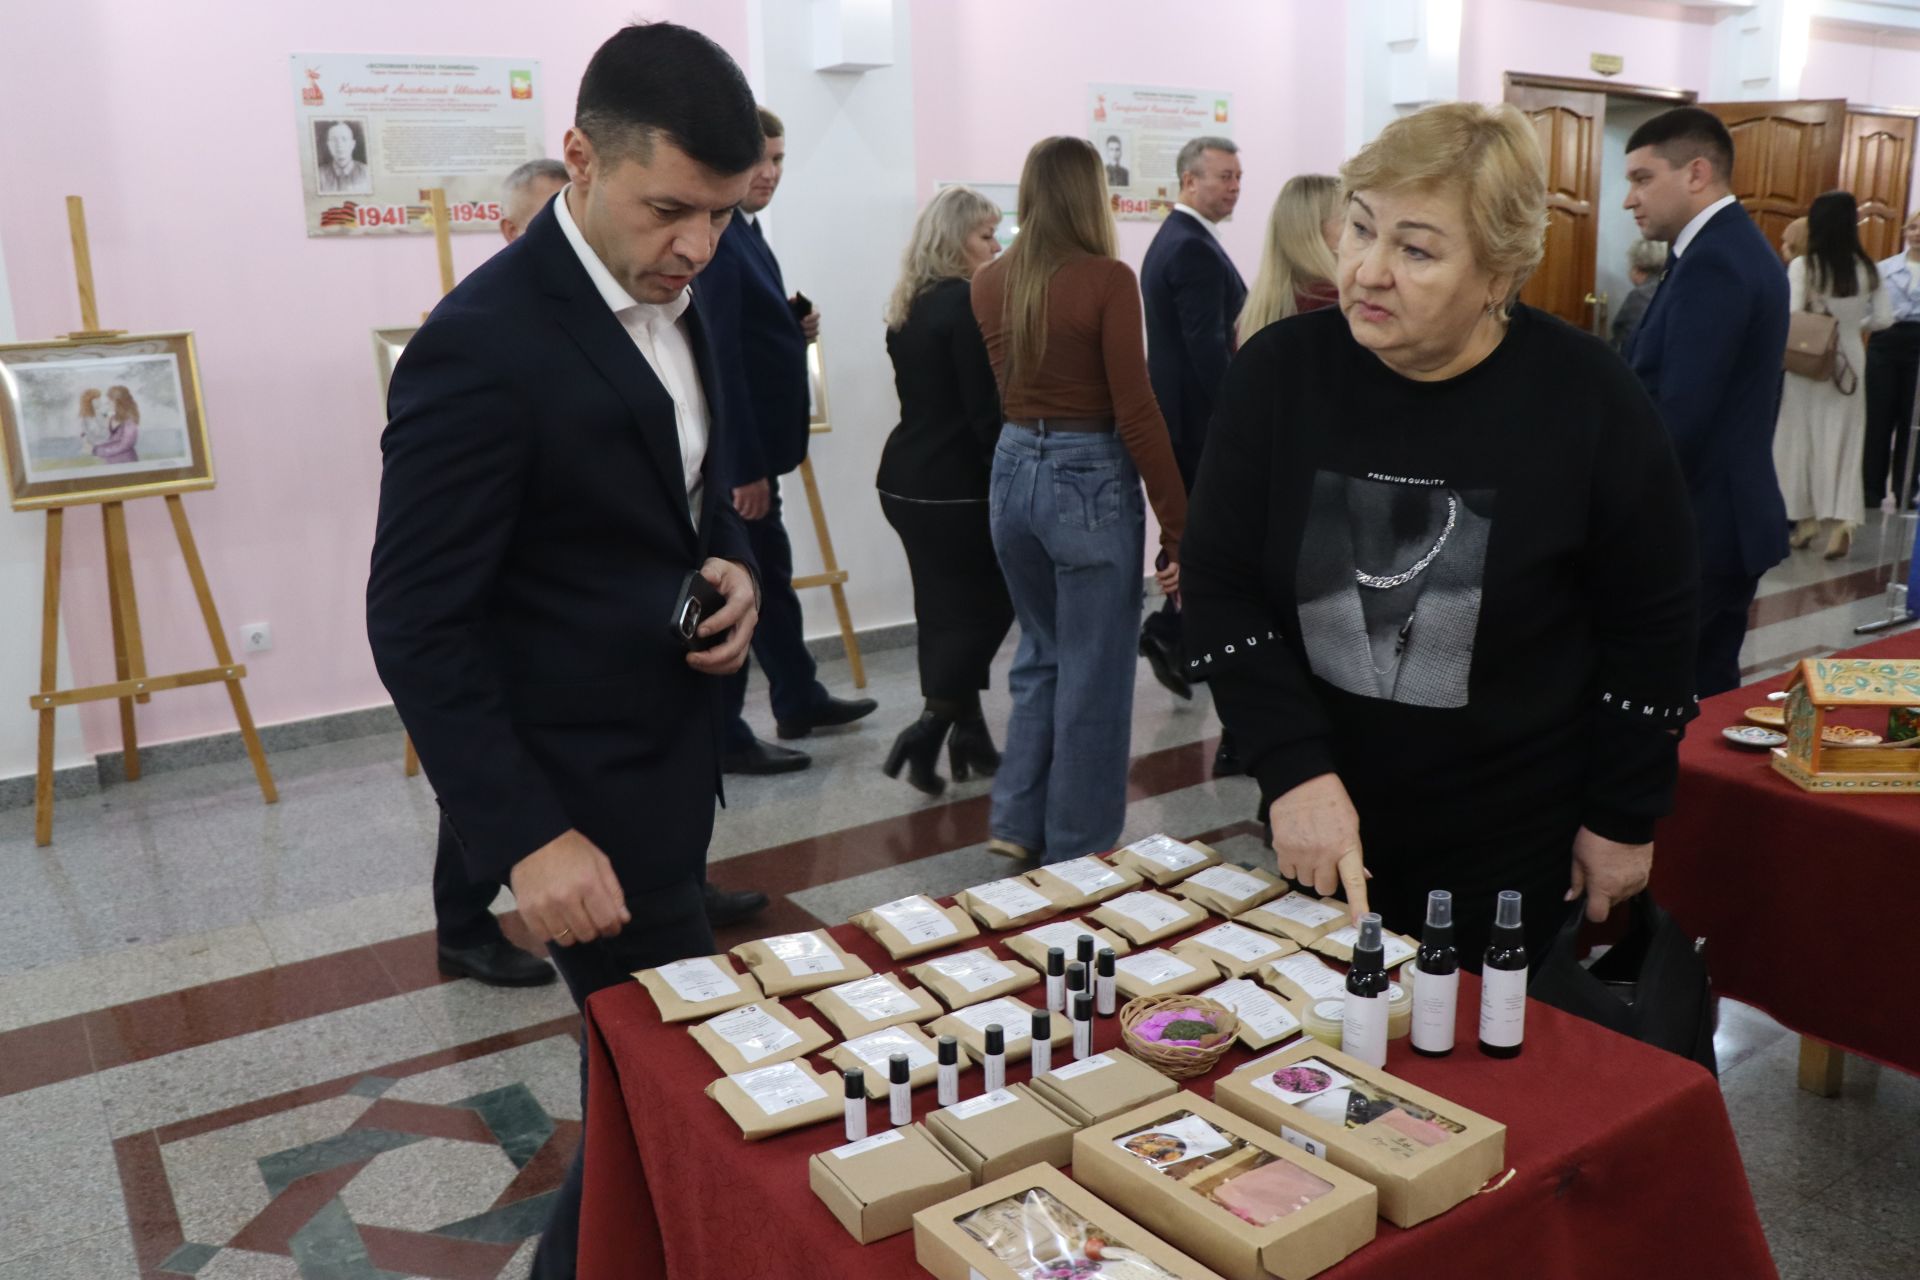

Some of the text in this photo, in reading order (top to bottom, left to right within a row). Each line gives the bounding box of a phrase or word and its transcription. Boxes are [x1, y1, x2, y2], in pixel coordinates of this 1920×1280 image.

[453, 204, 500, 221] 1945
[1120, 199, 1149, 213] 1941
[358, 207, 405, 225] 1941
[1367, 472, 1445, 486] PREMIUM QUALITY
